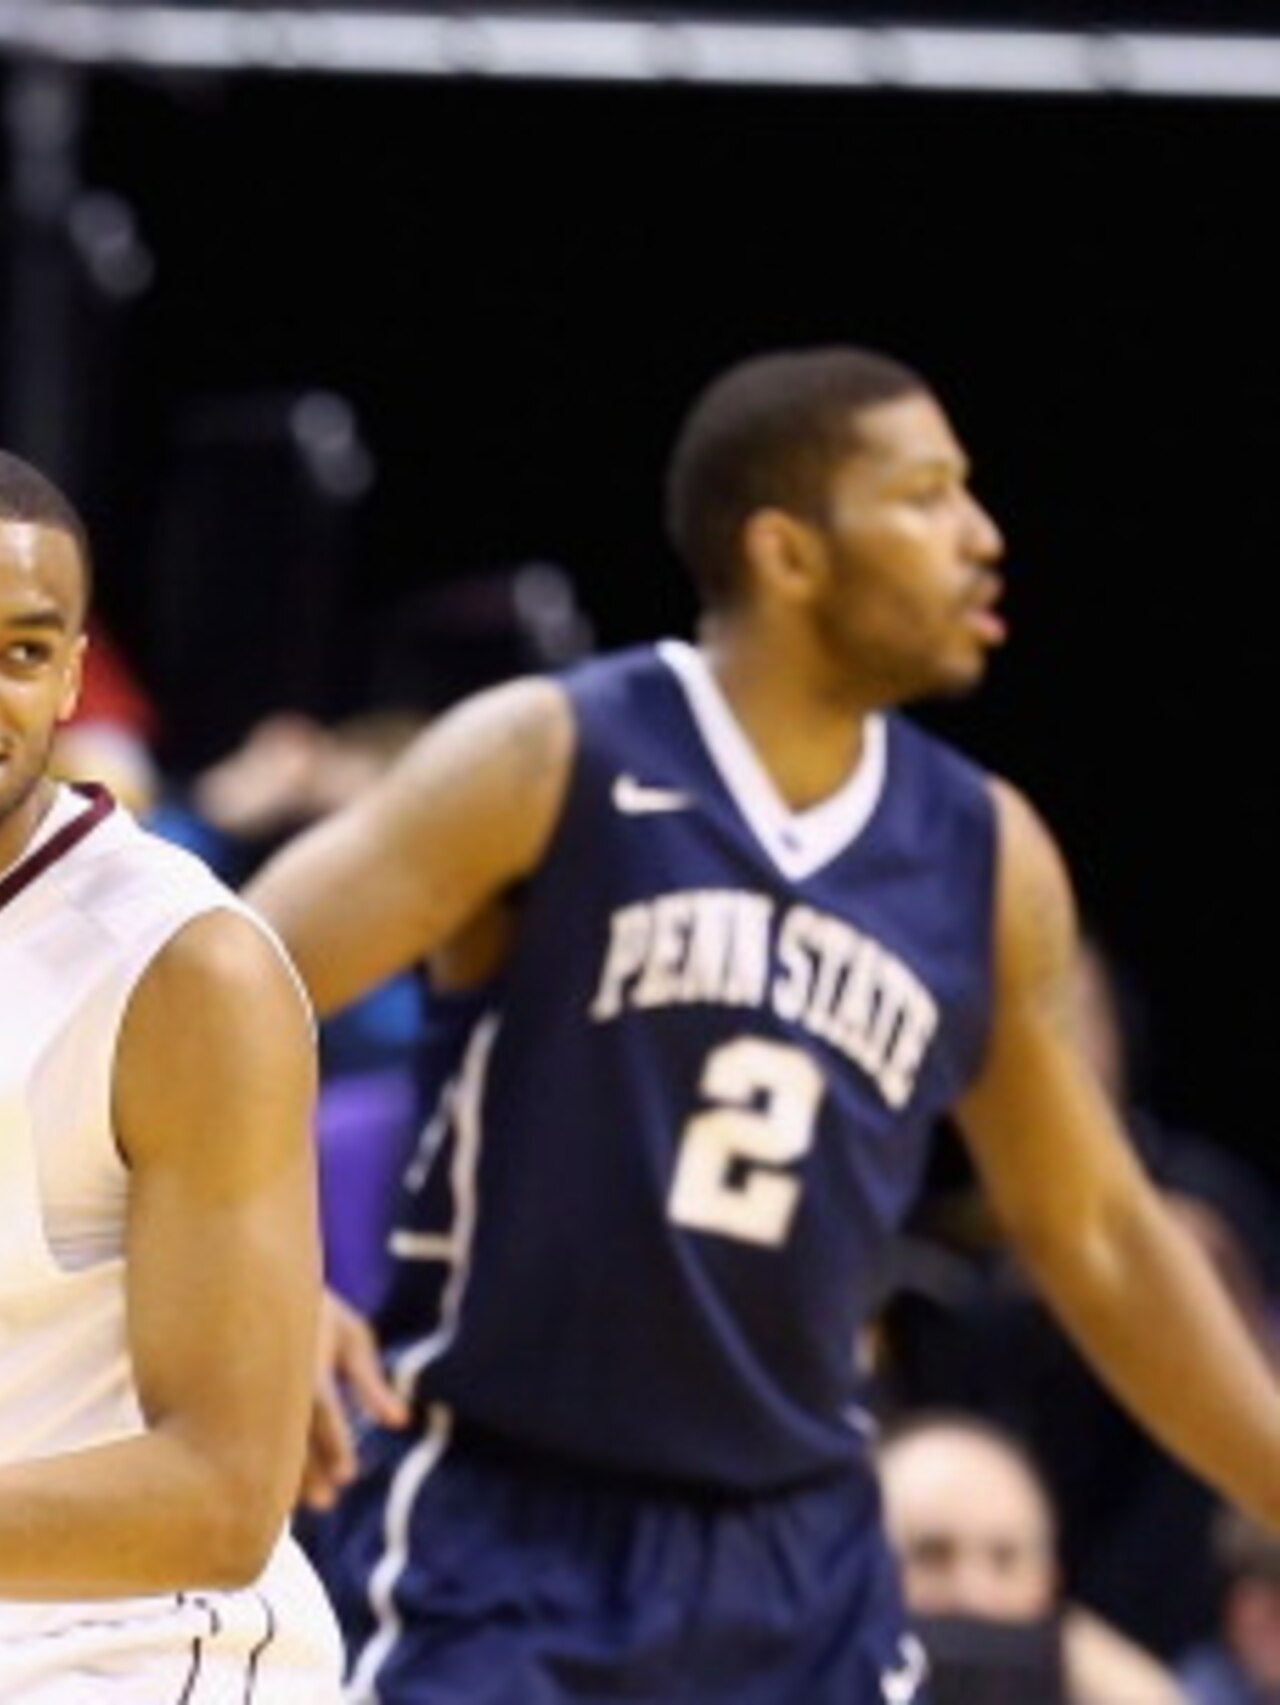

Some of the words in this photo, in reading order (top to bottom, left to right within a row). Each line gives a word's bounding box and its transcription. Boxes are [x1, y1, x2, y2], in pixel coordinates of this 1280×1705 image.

[589, 886, 775, 1022] PENN
[772, 904, 939, 1111] STATE
[667, 1034, 826, 1250] 2
